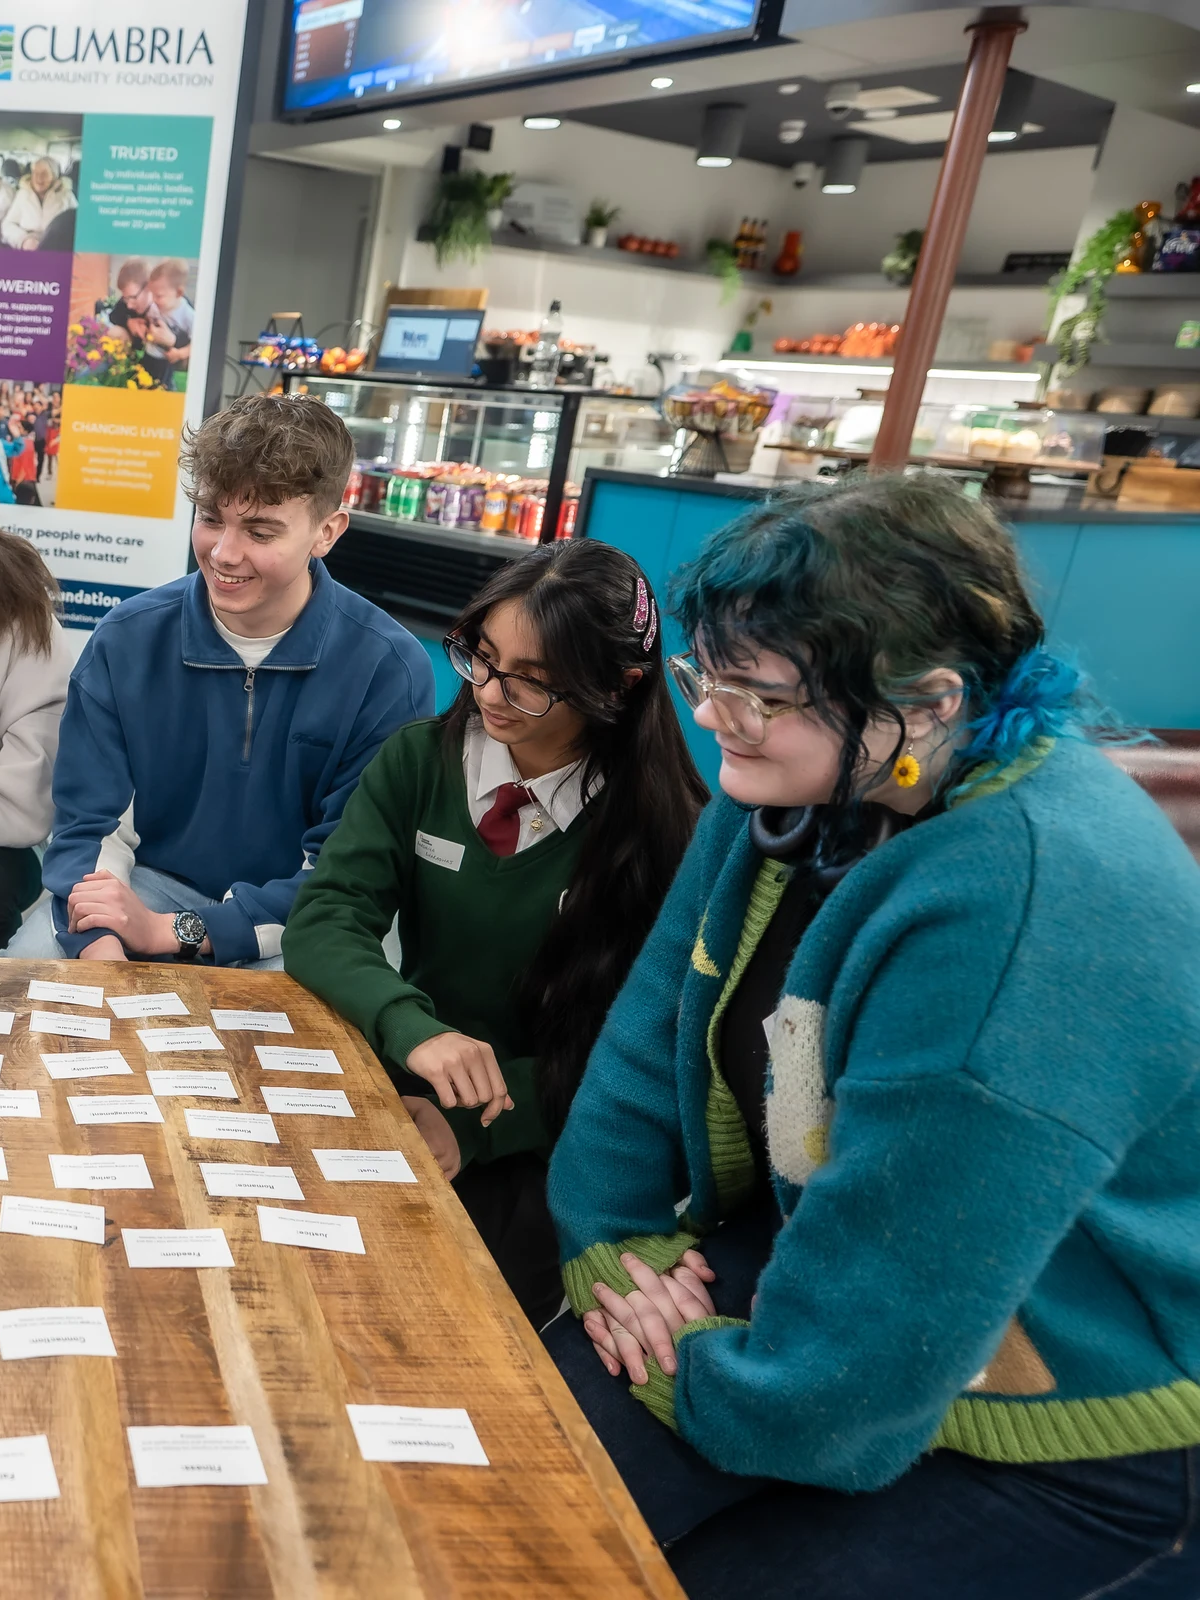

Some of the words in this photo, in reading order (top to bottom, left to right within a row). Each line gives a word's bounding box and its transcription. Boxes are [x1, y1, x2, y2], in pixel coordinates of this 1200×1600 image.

[20, 24, 214, 65] CUMBRIA
[18, 69, 111, 85] COMMUNITY
[116, 71, 214, 87] FOUNDATION
[110, 145, 178, 161] TRUSTED
[71, 420, 138, 437] CHANGING
[141, 426, 175, 440] LIVES
[36, 529, 81, 542] people
[84, 532, 113, 544] who
[116, 537, 144, 547] care
[53, 546, 80, 560] that
[83, 552, 129, 564] matter
